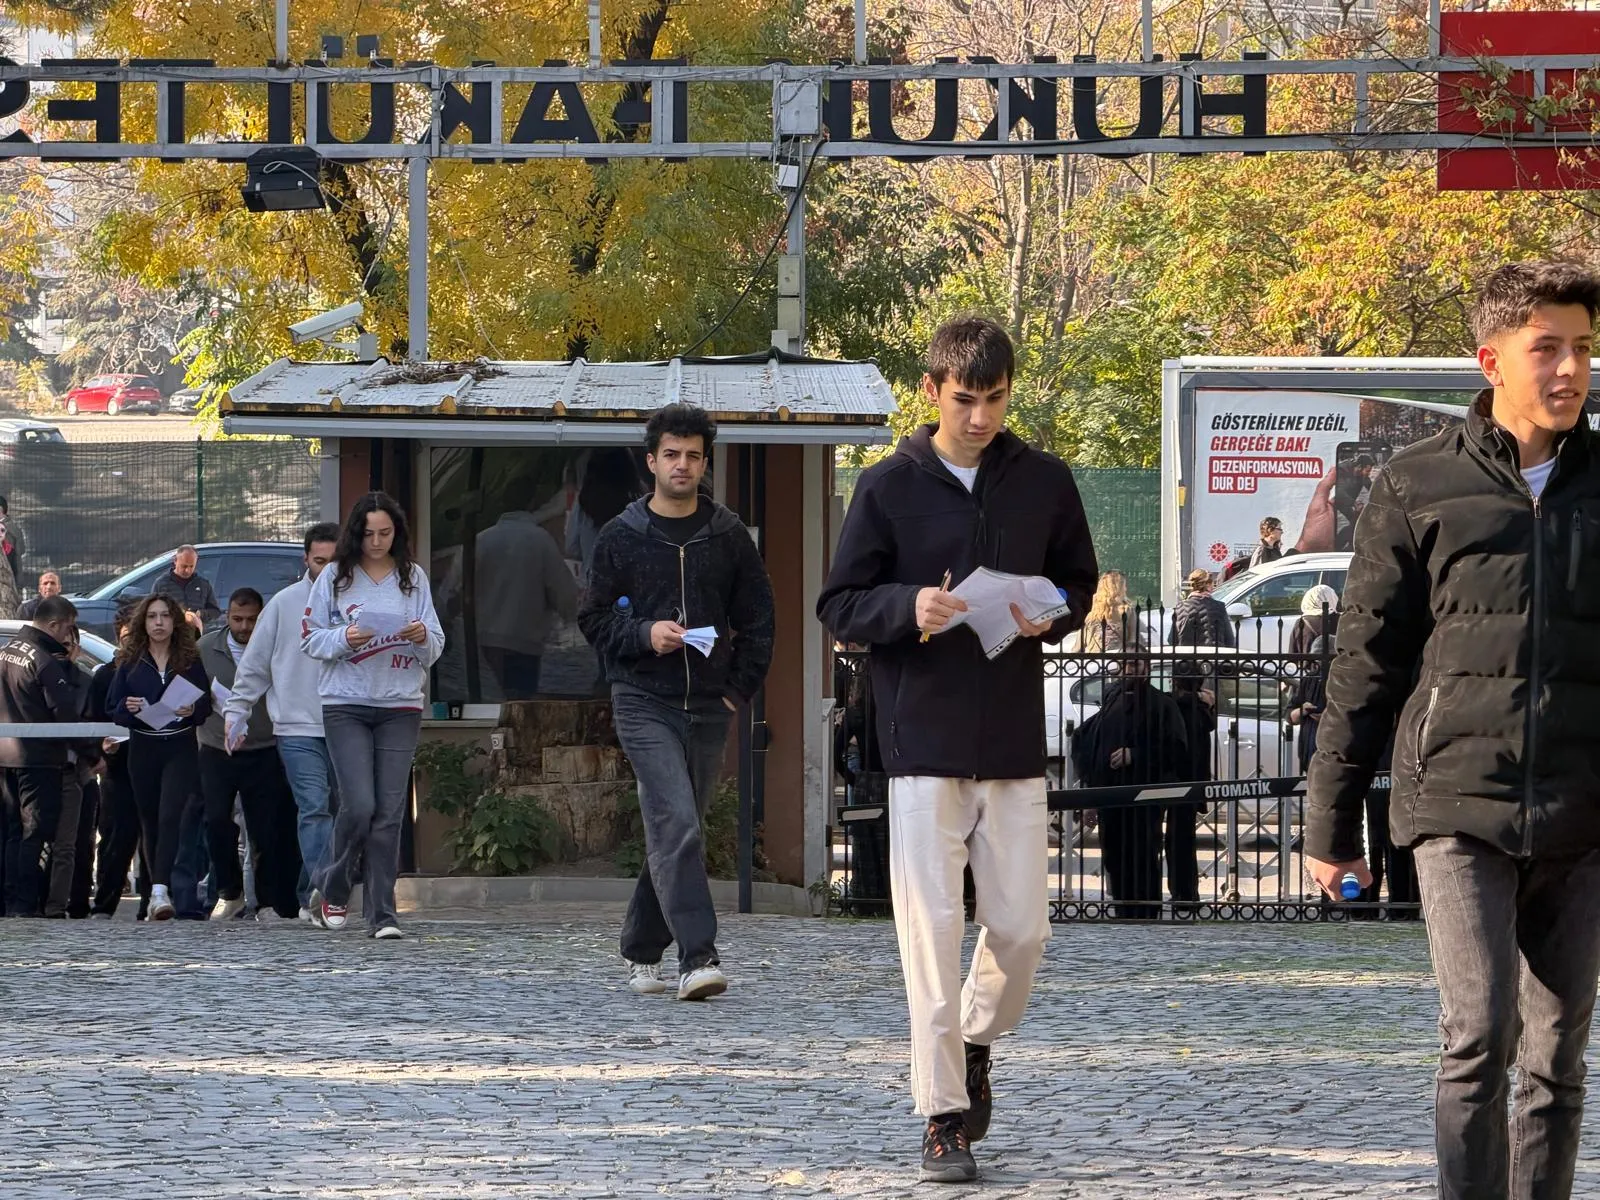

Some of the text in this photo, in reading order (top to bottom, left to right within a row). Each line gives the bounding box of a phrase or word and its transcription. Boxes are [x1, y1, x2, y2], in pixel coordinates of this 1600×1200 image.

[1211, 412, 1349, 432] GÖSTERİLENE DEĞİL,
[1210, 434, 1312, 454] GERÇEĞE BAK!
[1212, 460, 1321, 475] DEZENFORMASYONA
[1212, 476, 1255, 491] DUR DE!
[0, 650, 31, 669] ÜVENLİK
[390, 653, 414, 670] NY
[1204, 780, 1272, 799] OTOMATİK
